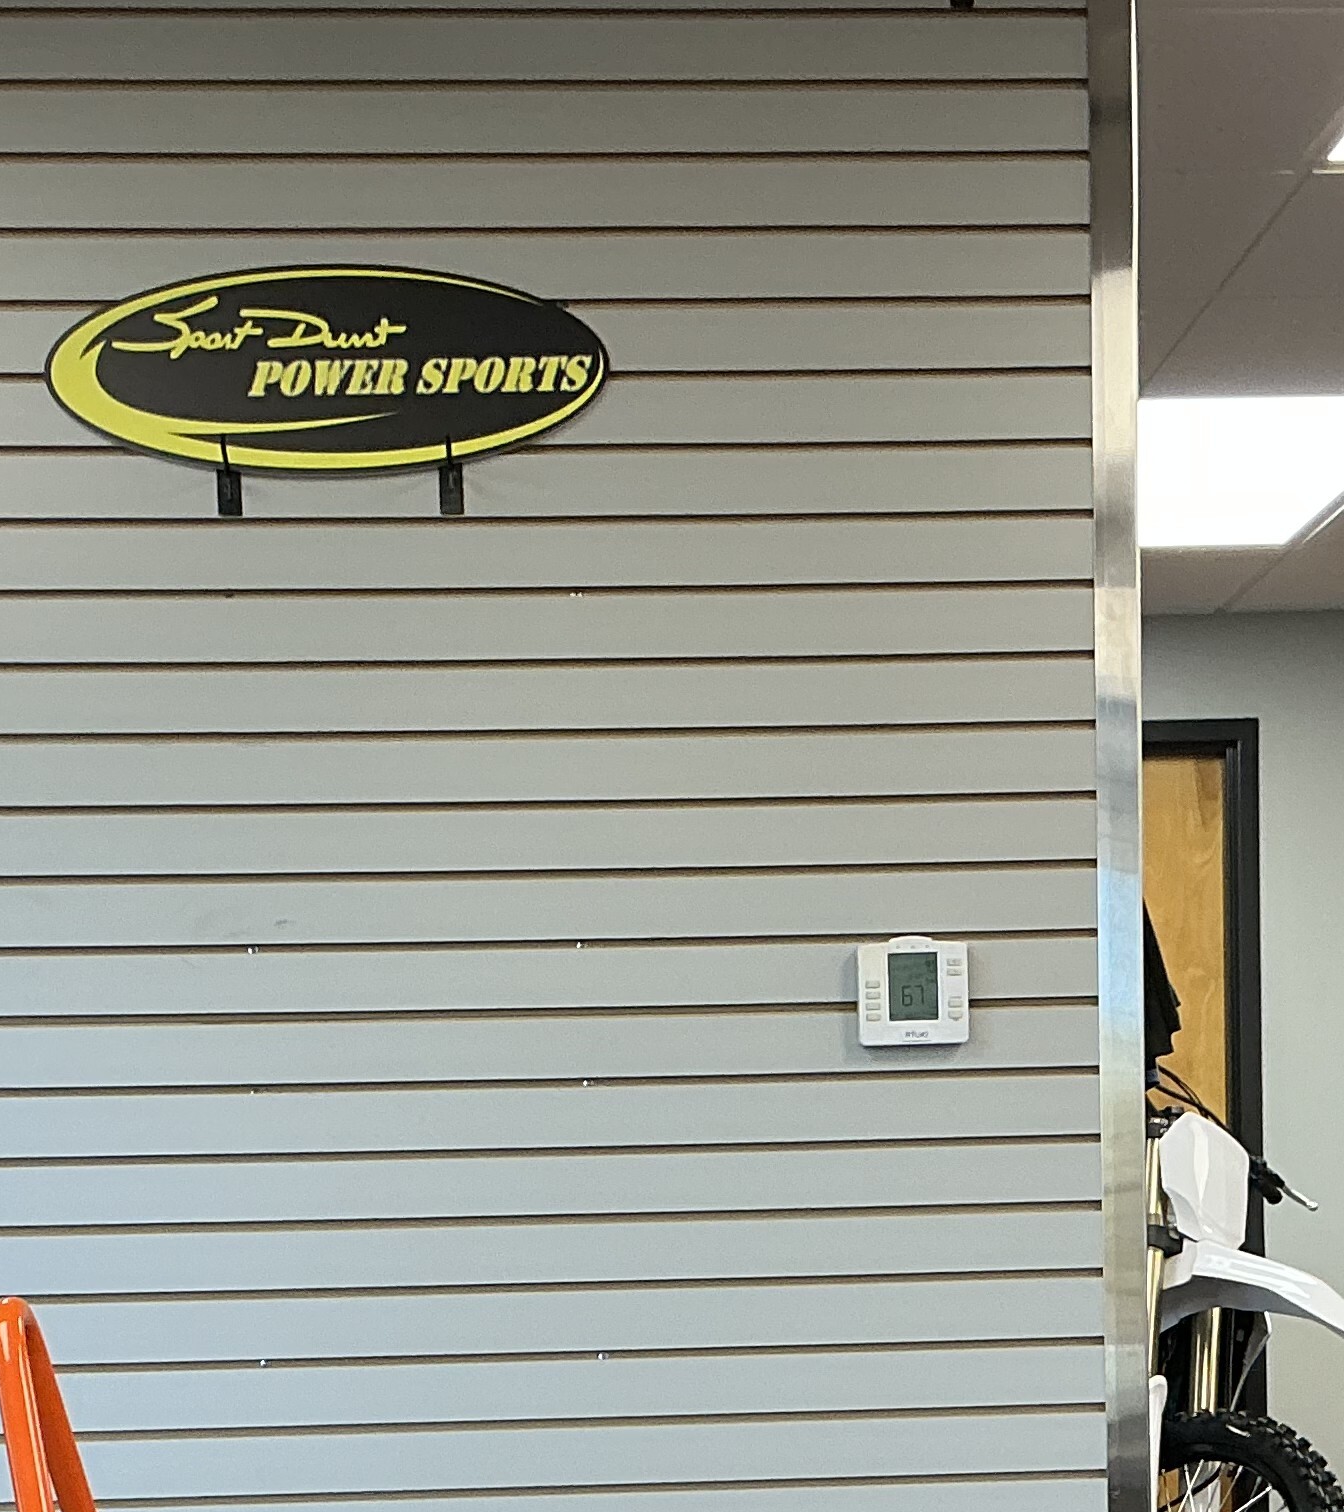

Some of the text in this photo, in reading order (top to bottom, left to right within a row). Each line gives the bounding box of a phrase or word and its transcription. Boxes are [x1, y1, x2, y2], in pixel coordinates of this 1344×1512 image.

[246, 355, 593, 397] POWER SPORTS
[901, 984, 925, 1007] 67
